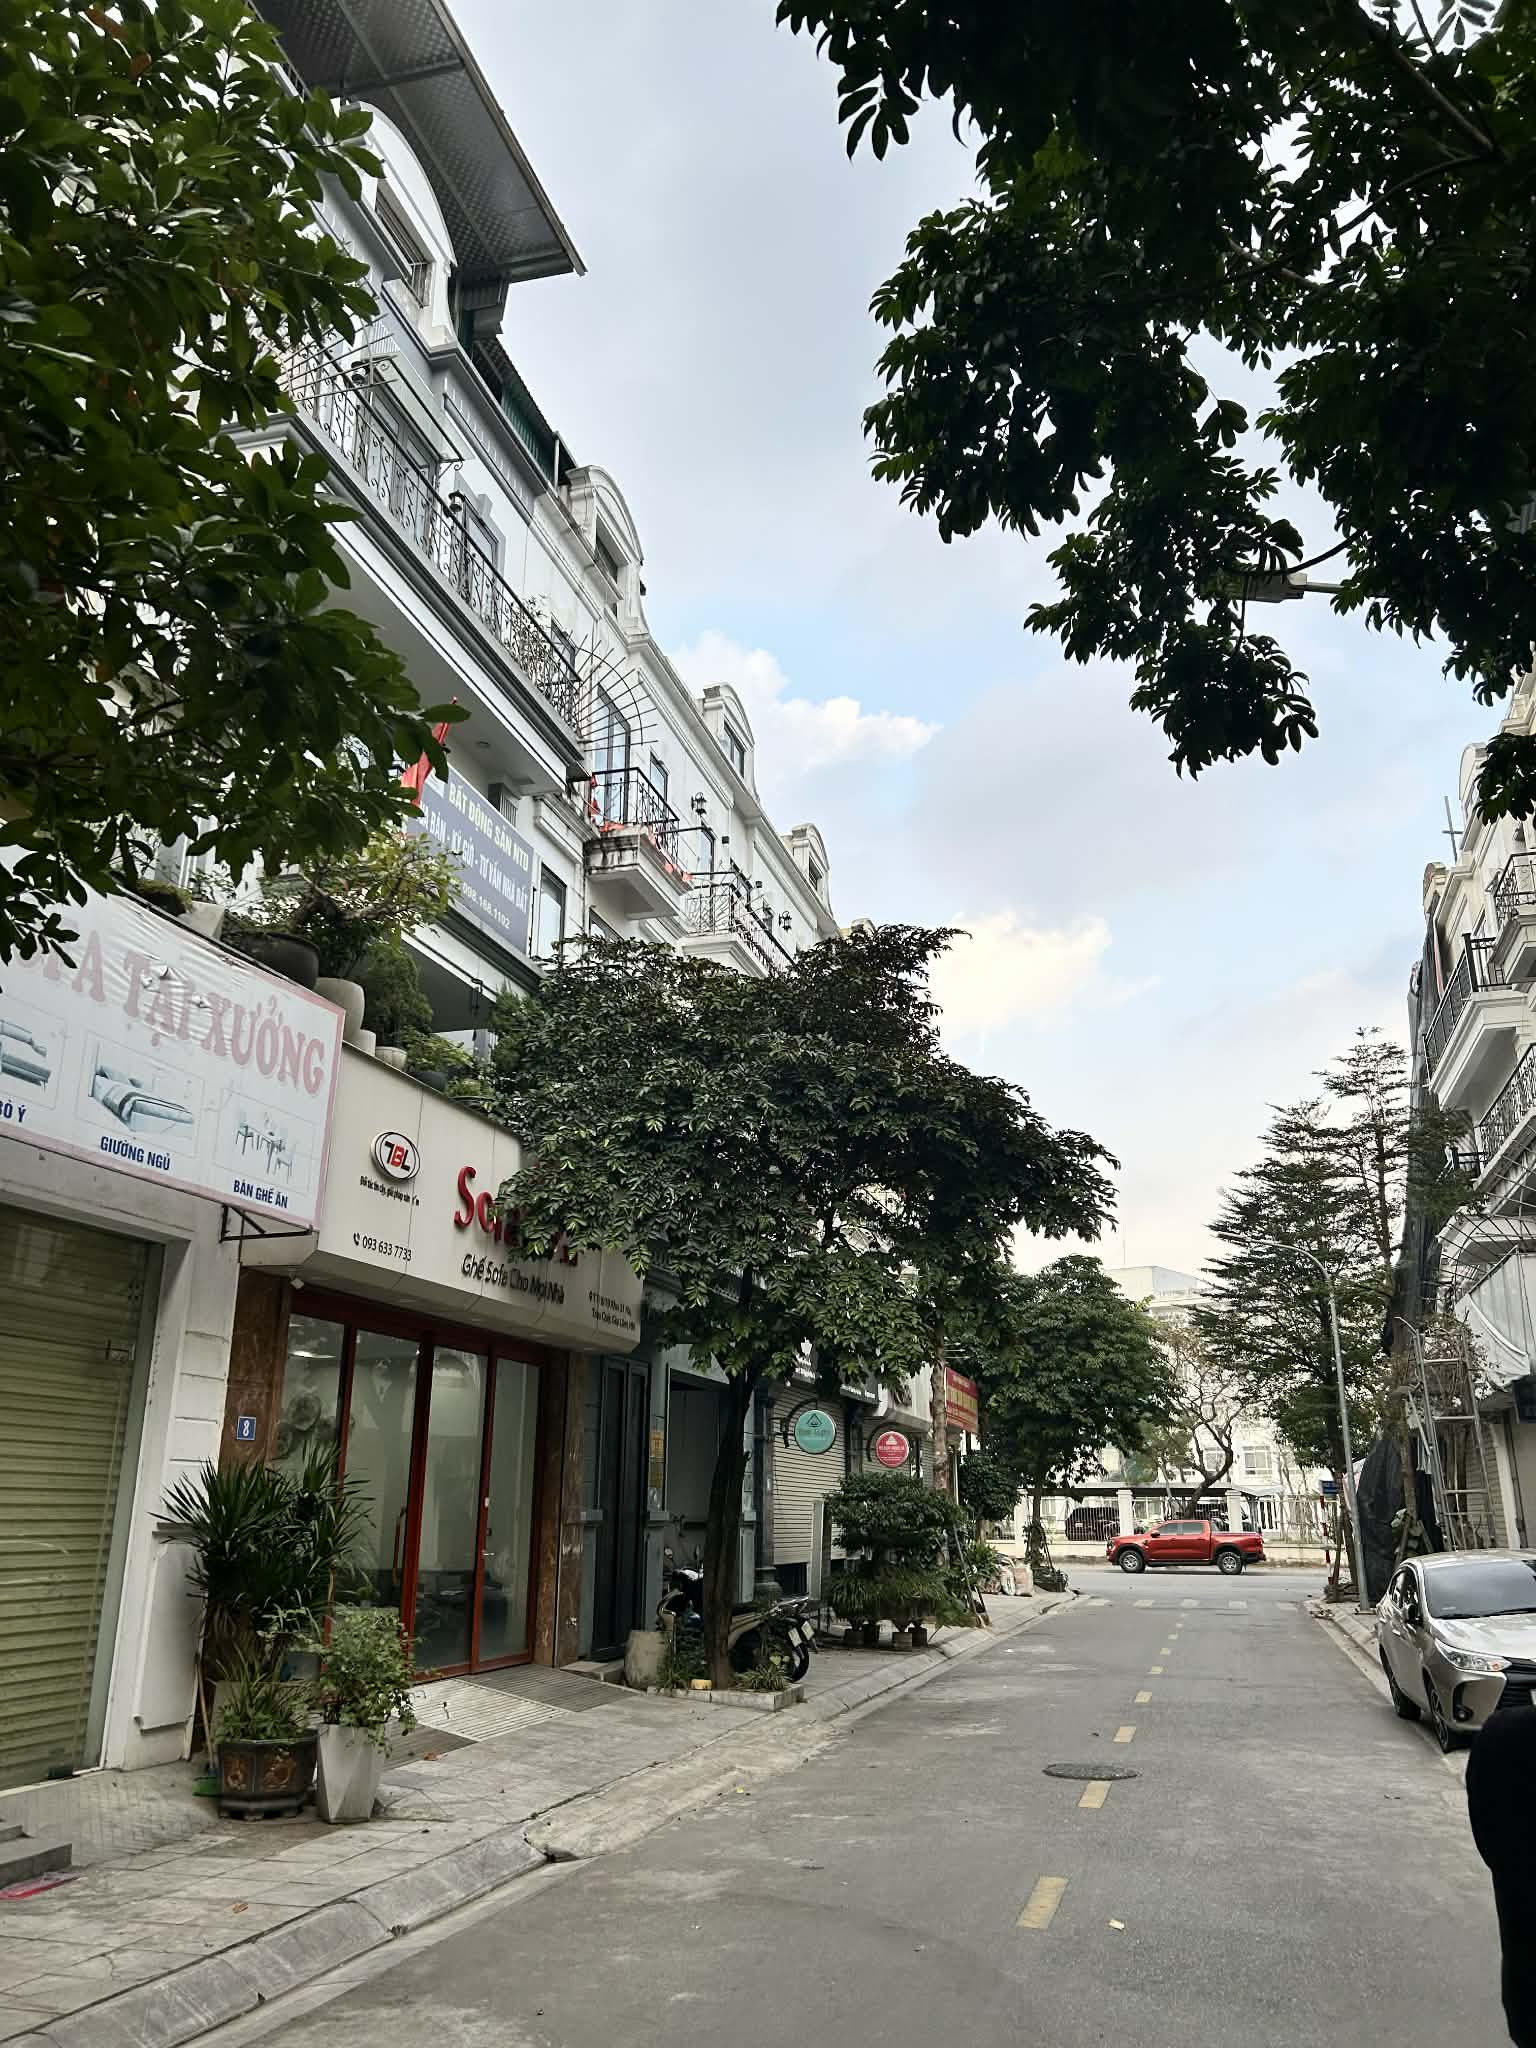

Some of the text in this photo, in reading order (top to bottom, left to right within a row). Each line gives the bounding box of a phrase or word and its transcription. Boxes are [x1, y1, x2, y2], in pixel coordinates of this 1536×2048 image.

[201, 992, 325, 1095] XƯỞNG
[100, 1135, 171, 1171] GIƯỜNG NGỦ
[233, 1179, 288, 1209] BÀN GHẾ ĂN
[362, 1235, 412, 1262] 093 633 7733
[462, 1254, 487, 1280] Ghế
[242, 1419, 250, 1437] 8
